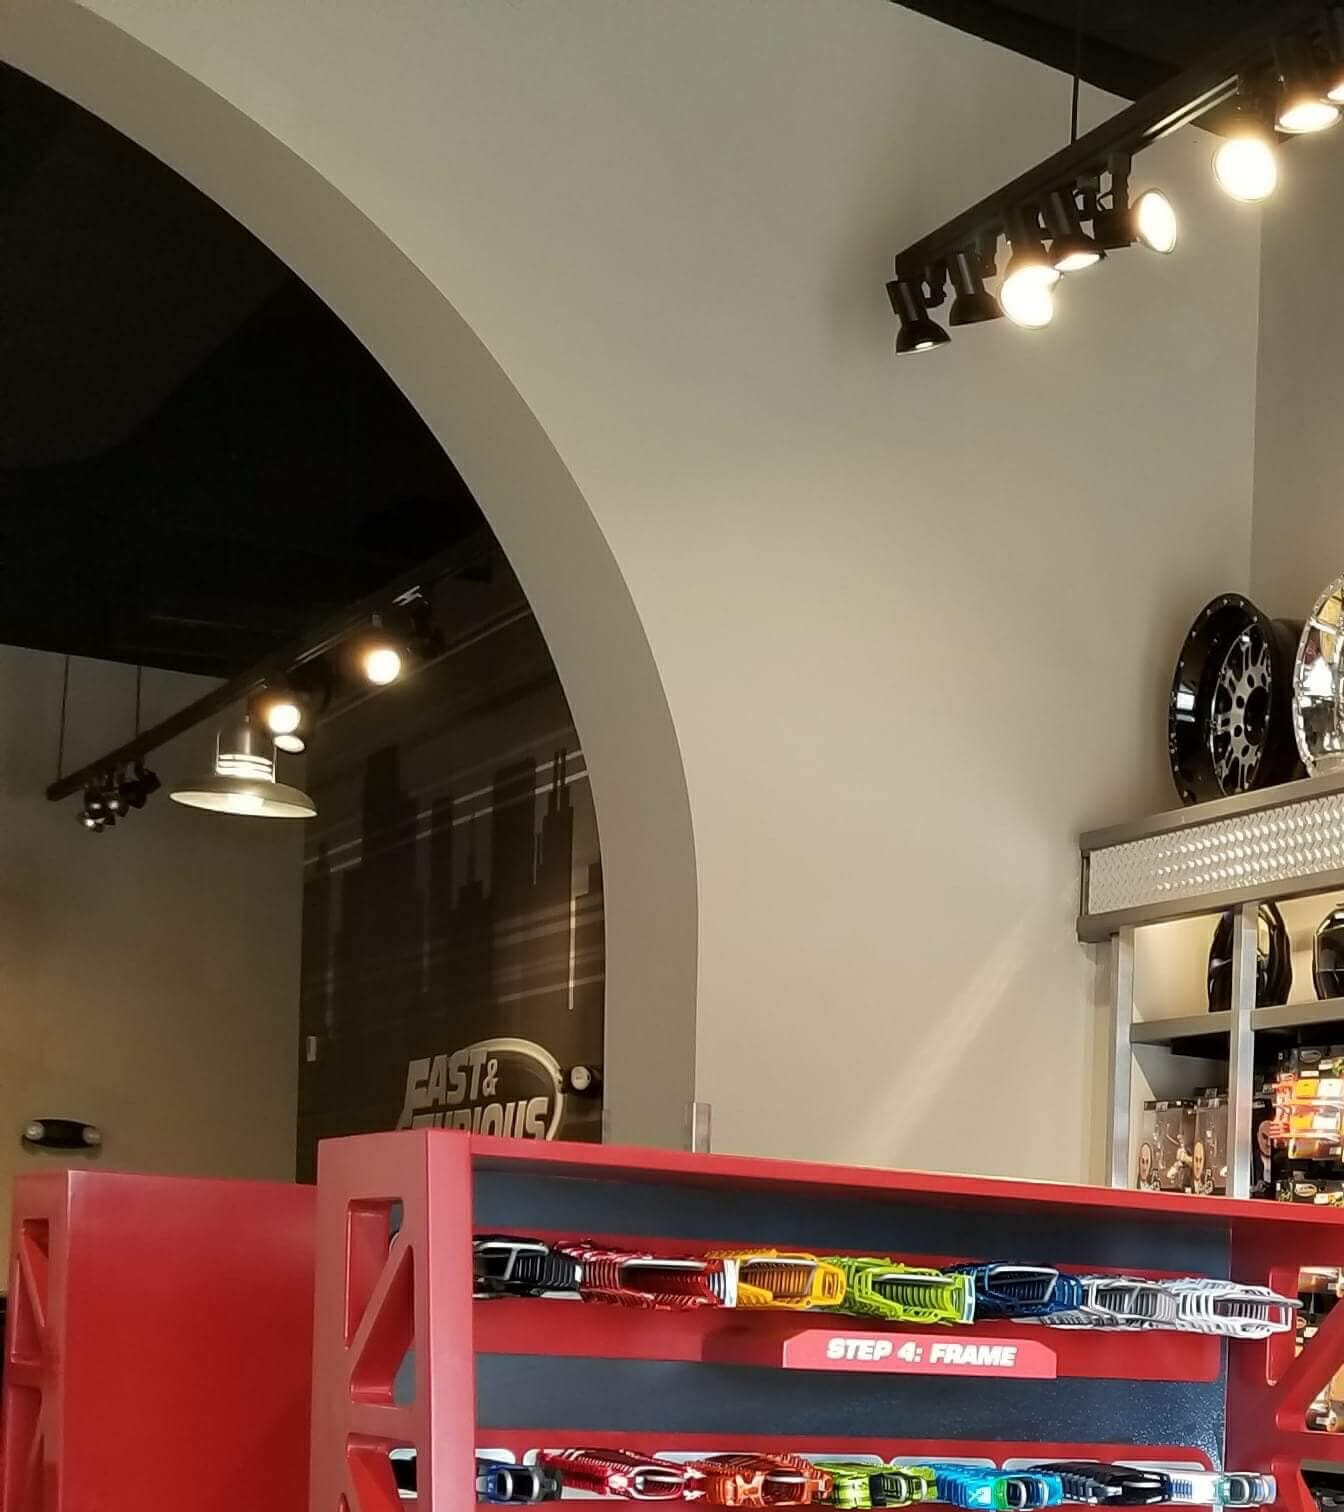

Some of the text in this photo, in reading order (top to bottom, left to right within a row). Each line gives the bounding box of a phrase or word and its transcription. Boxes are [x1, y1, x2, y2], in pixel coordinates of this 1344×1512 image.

[826, 1338, 1018, 1367] STEP 4: FRAME
